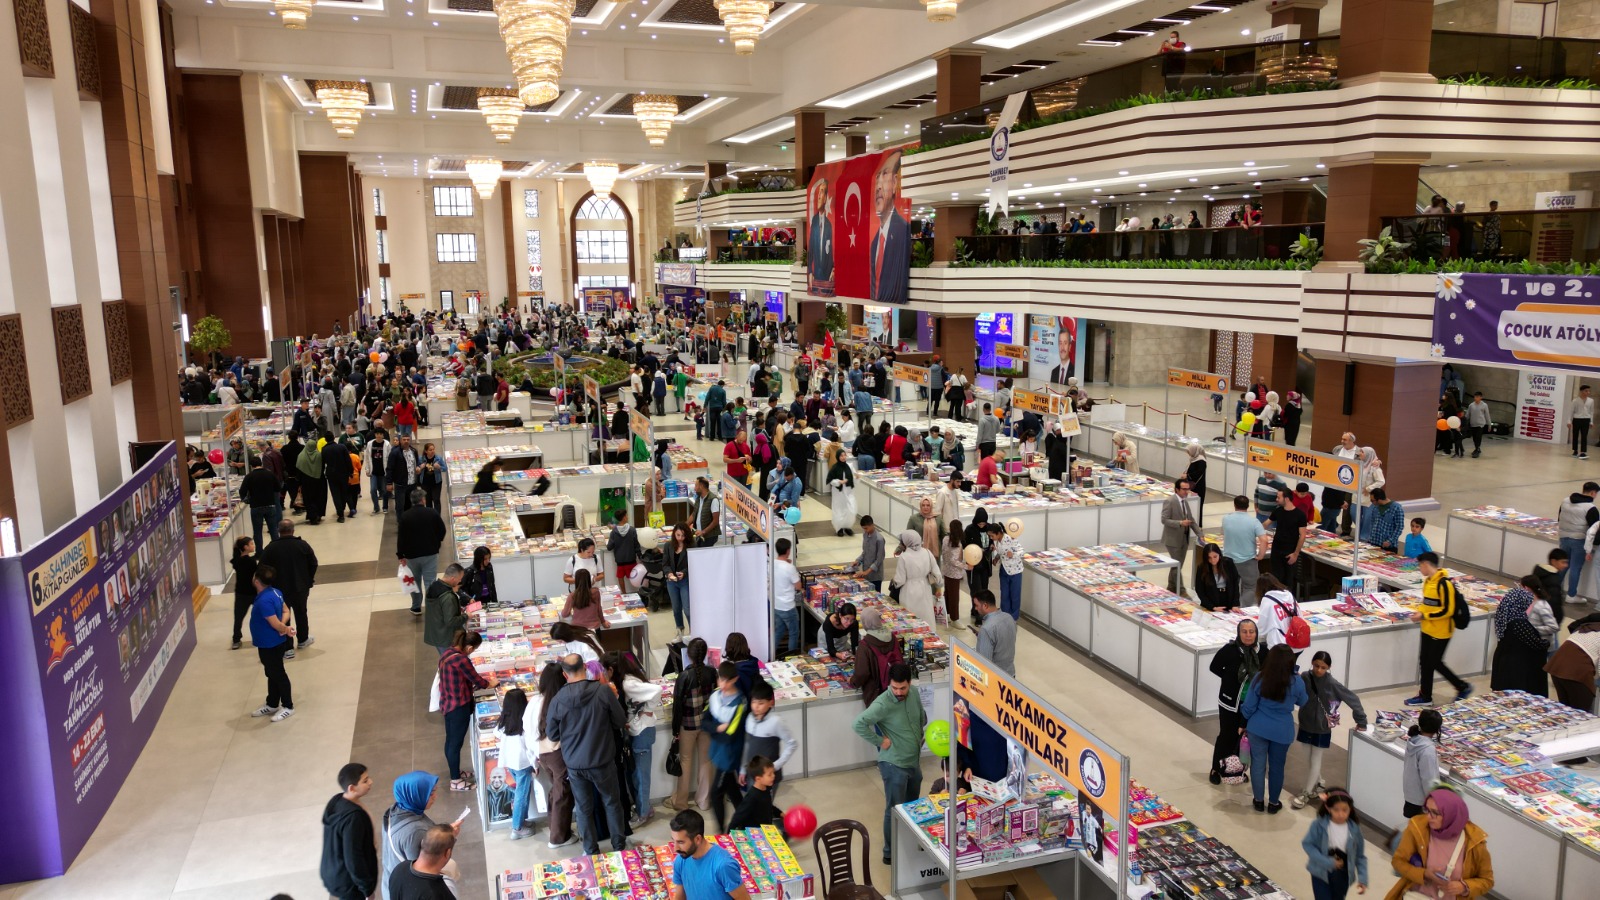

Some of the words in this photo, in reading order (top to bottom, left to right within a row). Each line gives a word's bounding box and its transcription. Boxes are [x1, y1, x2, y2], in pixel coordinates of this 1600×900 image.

[1501, 278, 1518, 295] 1.
[1526, 282, 1556, 296] ve
[1564, 278, 1592, 298] 2.
[1504, 323, 1552, 339] ÇOCUK
[1556, 324, 1600, 342] ATÖLY
[1186, 381, 1211, 390] OYUNLAR
[1191, 374, 1206, 382] MİLLİ
[1533, 376, 1556, 387] ÇOCUK
[1034, 395, 1048, 405] SİYER
[1286, 452, 1320, 468] PROFİL
[1288, 465, 1316, 479] KİTAP
[42, 575, 63, 602] KİTAP
[63, 555, 90, 585] GÜNLERİ
[32, 571, 43, 606] 6
[72, 583, 100, 622] HAYATTIR
[75, 612, 102, 646] KİTAPTIR
[63, 678, 104, 734] TAHMAZOĞLU
[997, 680, 1067, 748] YAKAMOZ
[995, 703, 1069, 778] YAYINLARI
[920, 867, 945, 878] IBRA
